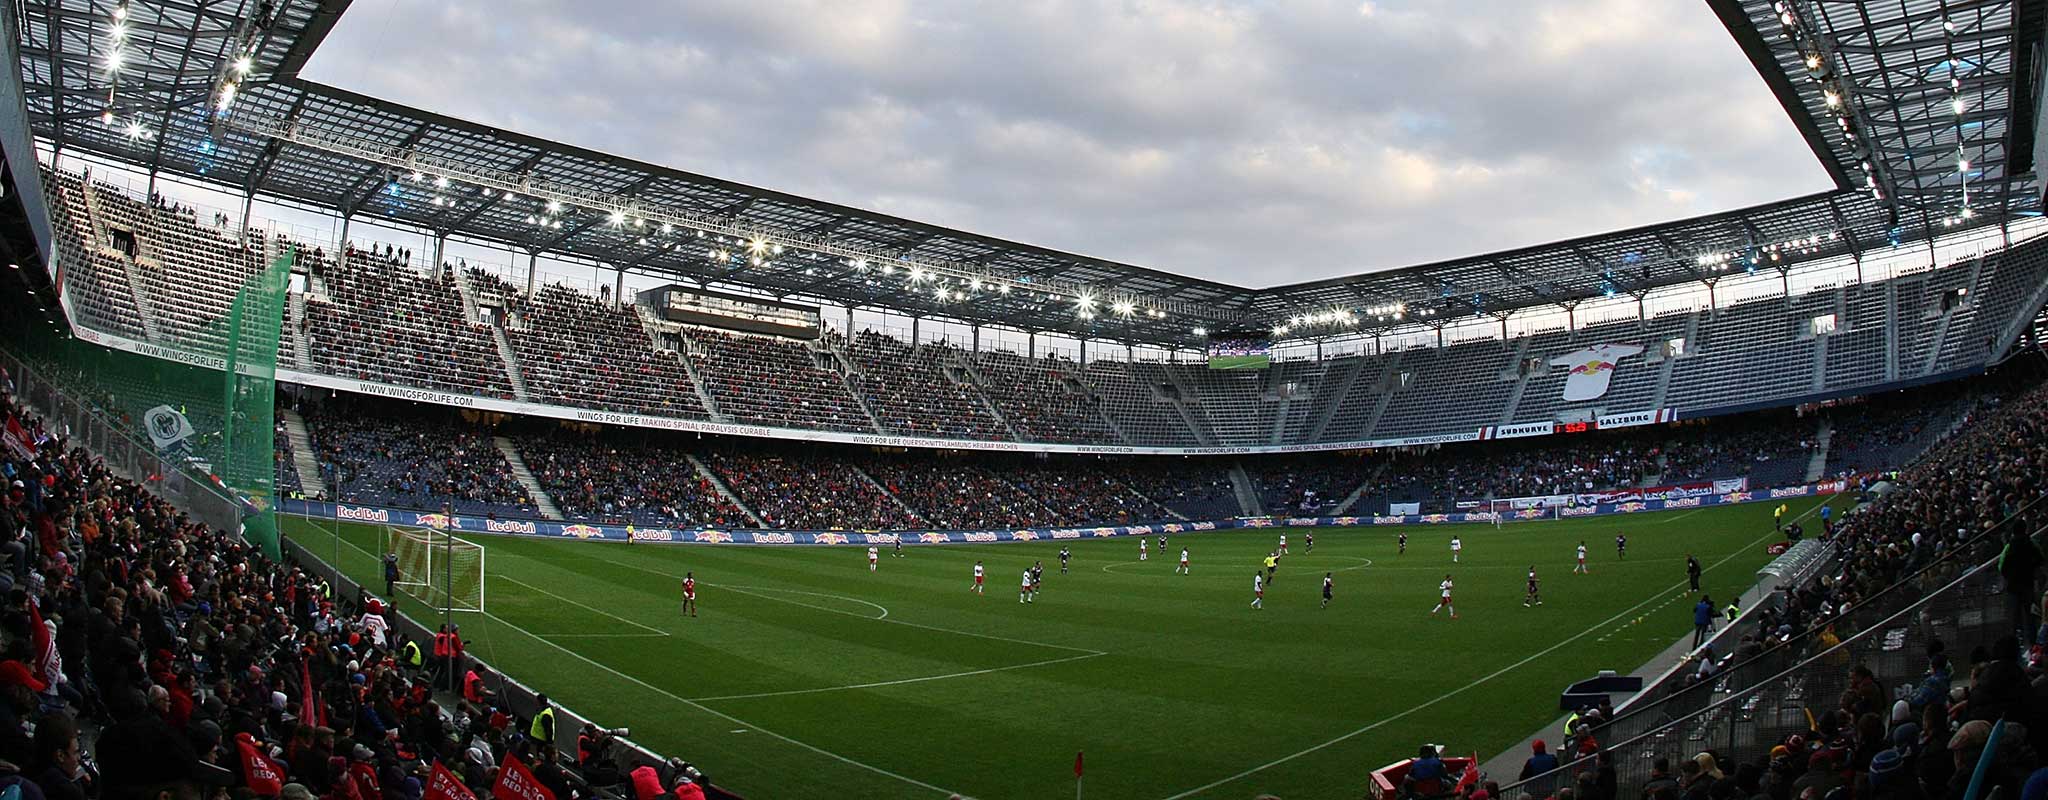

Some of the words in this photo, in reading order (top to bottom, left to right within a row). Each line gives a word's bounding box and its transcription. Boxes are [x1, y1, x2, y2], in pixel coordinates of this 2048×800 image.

[135, 343, 247, 373] WWW.WINGSFORLIFE.OM
[359, 383, 473, 406] WWW.WINGSFORLIFE.COM
[577, 411, 604, 422] WINGS
[605, 414, 621, 424] FOR
[623, 416, 639, 426] LIFE
[641, 417, 672, 428] MAKING
[673, 421, 699, 431] SPINAL
[701, 423, 738, 434] PARALYSIS
[739, 426, 771, 437] CURABLE
[1600, 414, 1649, 426] SALZBURG
[852, 436, 874, 444] WINGS
[875, 437, 887, 445] FOR
[502, 777, 521, 793] RED
